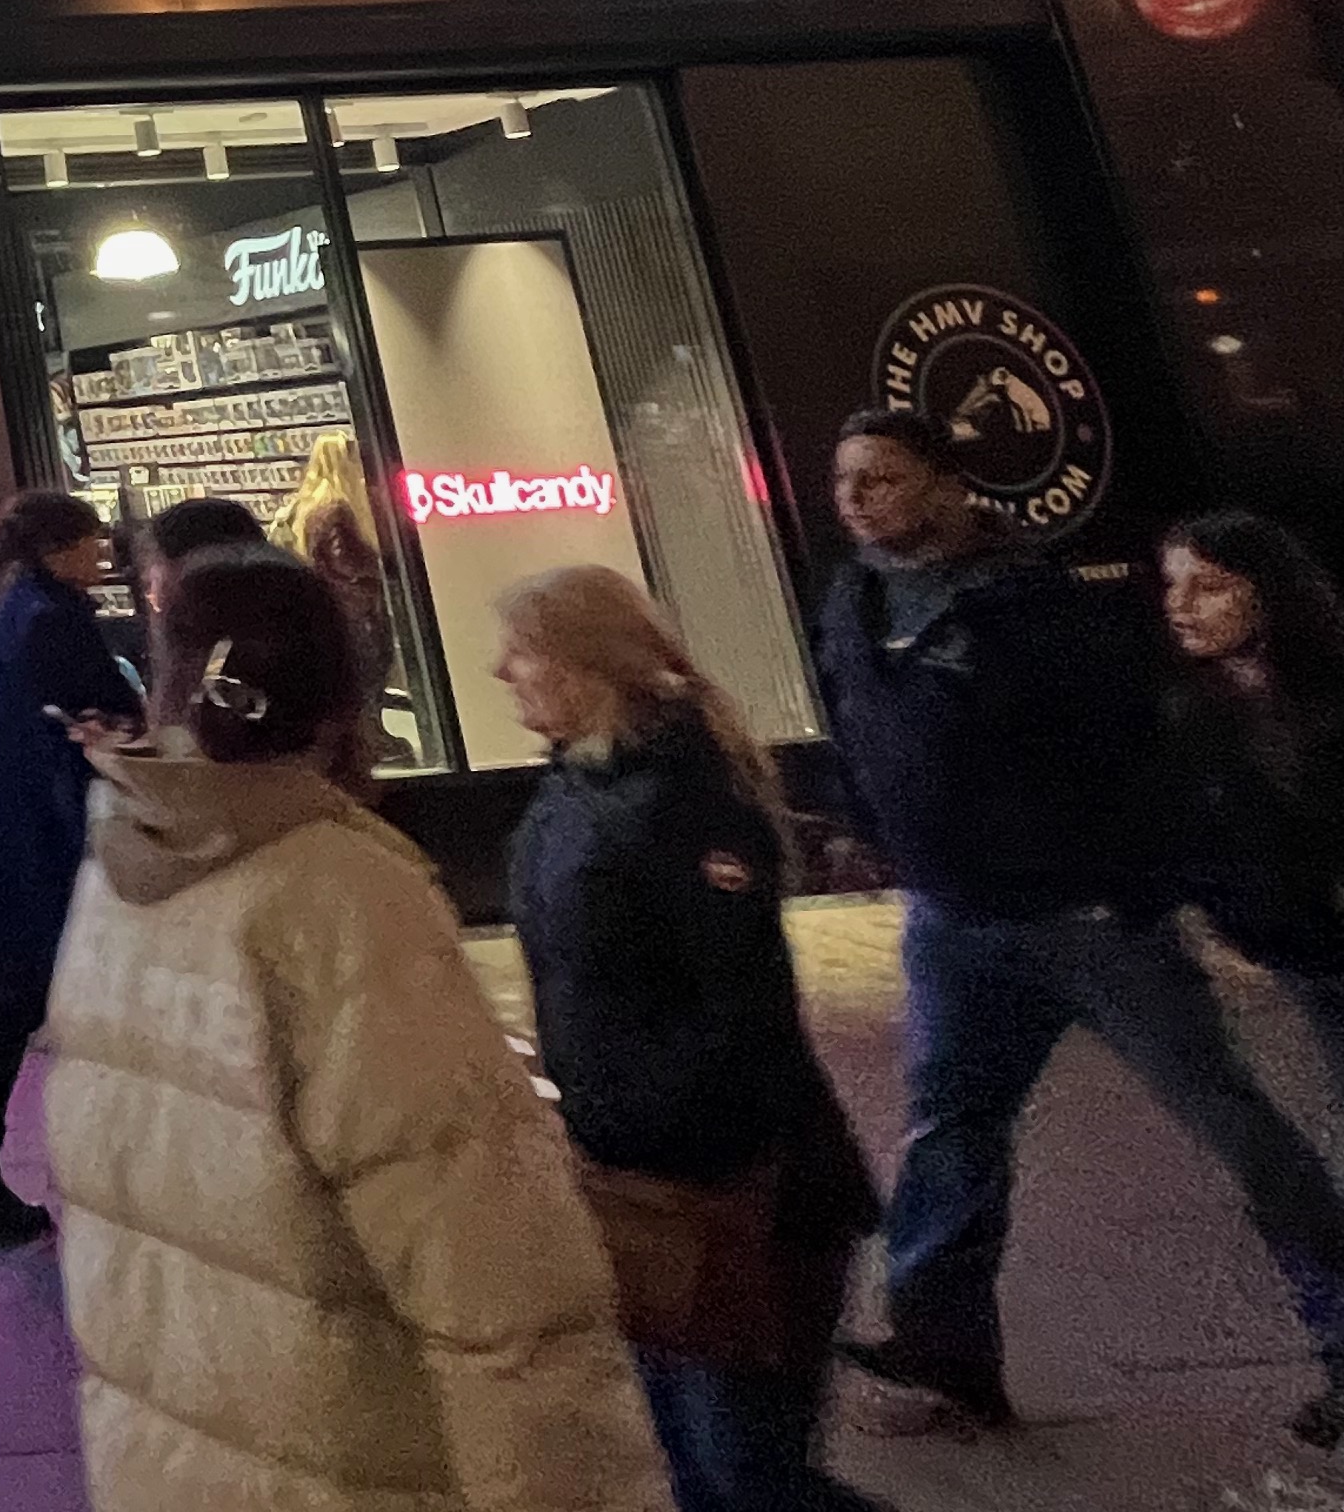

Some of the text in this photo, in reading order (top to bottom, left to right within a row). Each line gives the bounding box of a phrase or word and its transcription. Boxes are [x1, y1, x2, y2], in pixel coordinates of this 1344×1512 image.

[885, 297, 1086, 412] THE HMV SHOP
[432, 463, 614, 517] Skullcandy
